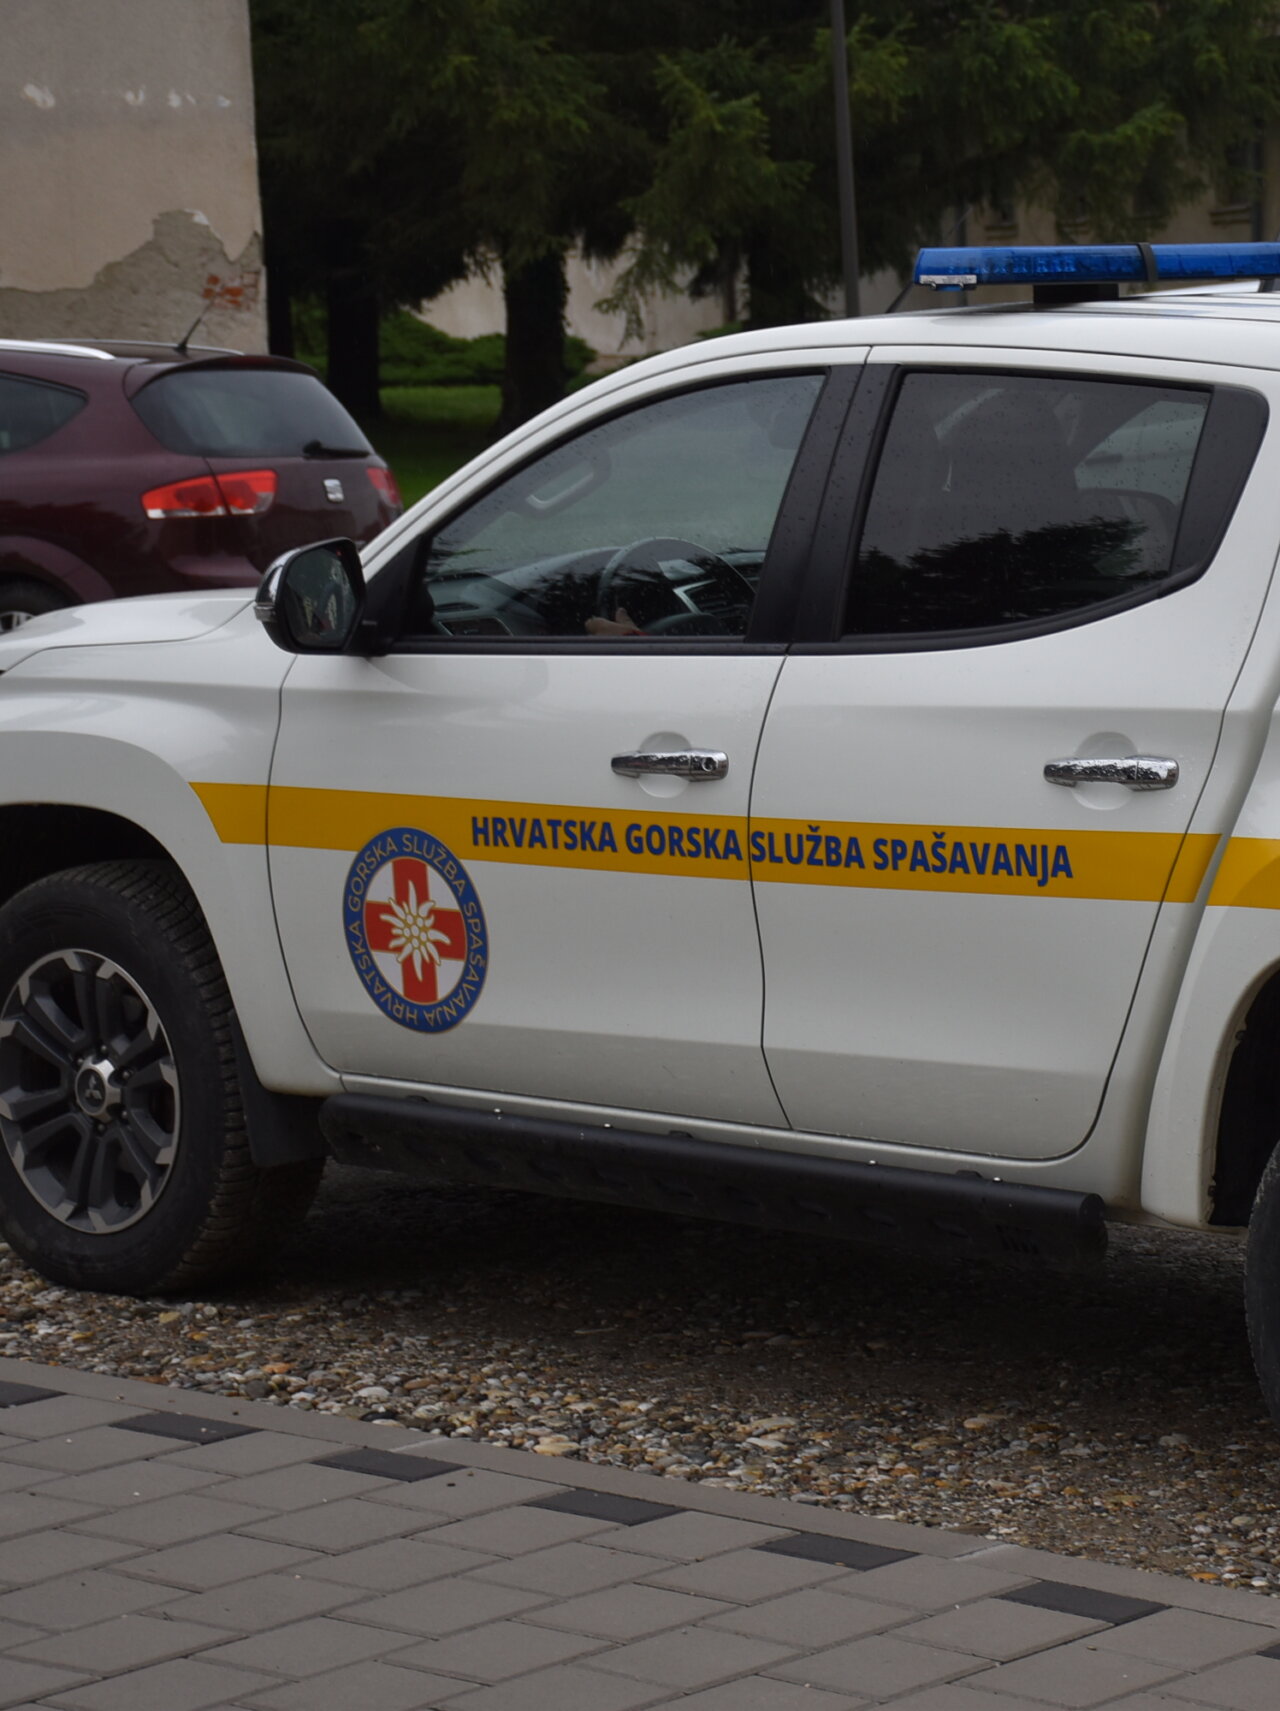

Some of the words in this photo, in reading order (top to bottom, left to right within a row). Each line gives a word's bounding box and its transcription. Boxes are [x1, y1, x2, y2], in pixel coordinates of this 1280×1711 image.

[348, 836, 398, 912] GORSKA
[402, 833, 467, 897] SLUŽBA
[471, 816, 618, 853] HRVATSKA
[625, 823, 743, 861] GORSKA
[751, 824, 866, 869] SLUŽBA
[873, 831, 1074, 887] SPAŠAVANJA
[348, 921, 419, 1026] HRVATSKA
[423, 901, 486, 1028] SPAŠAVANJA
